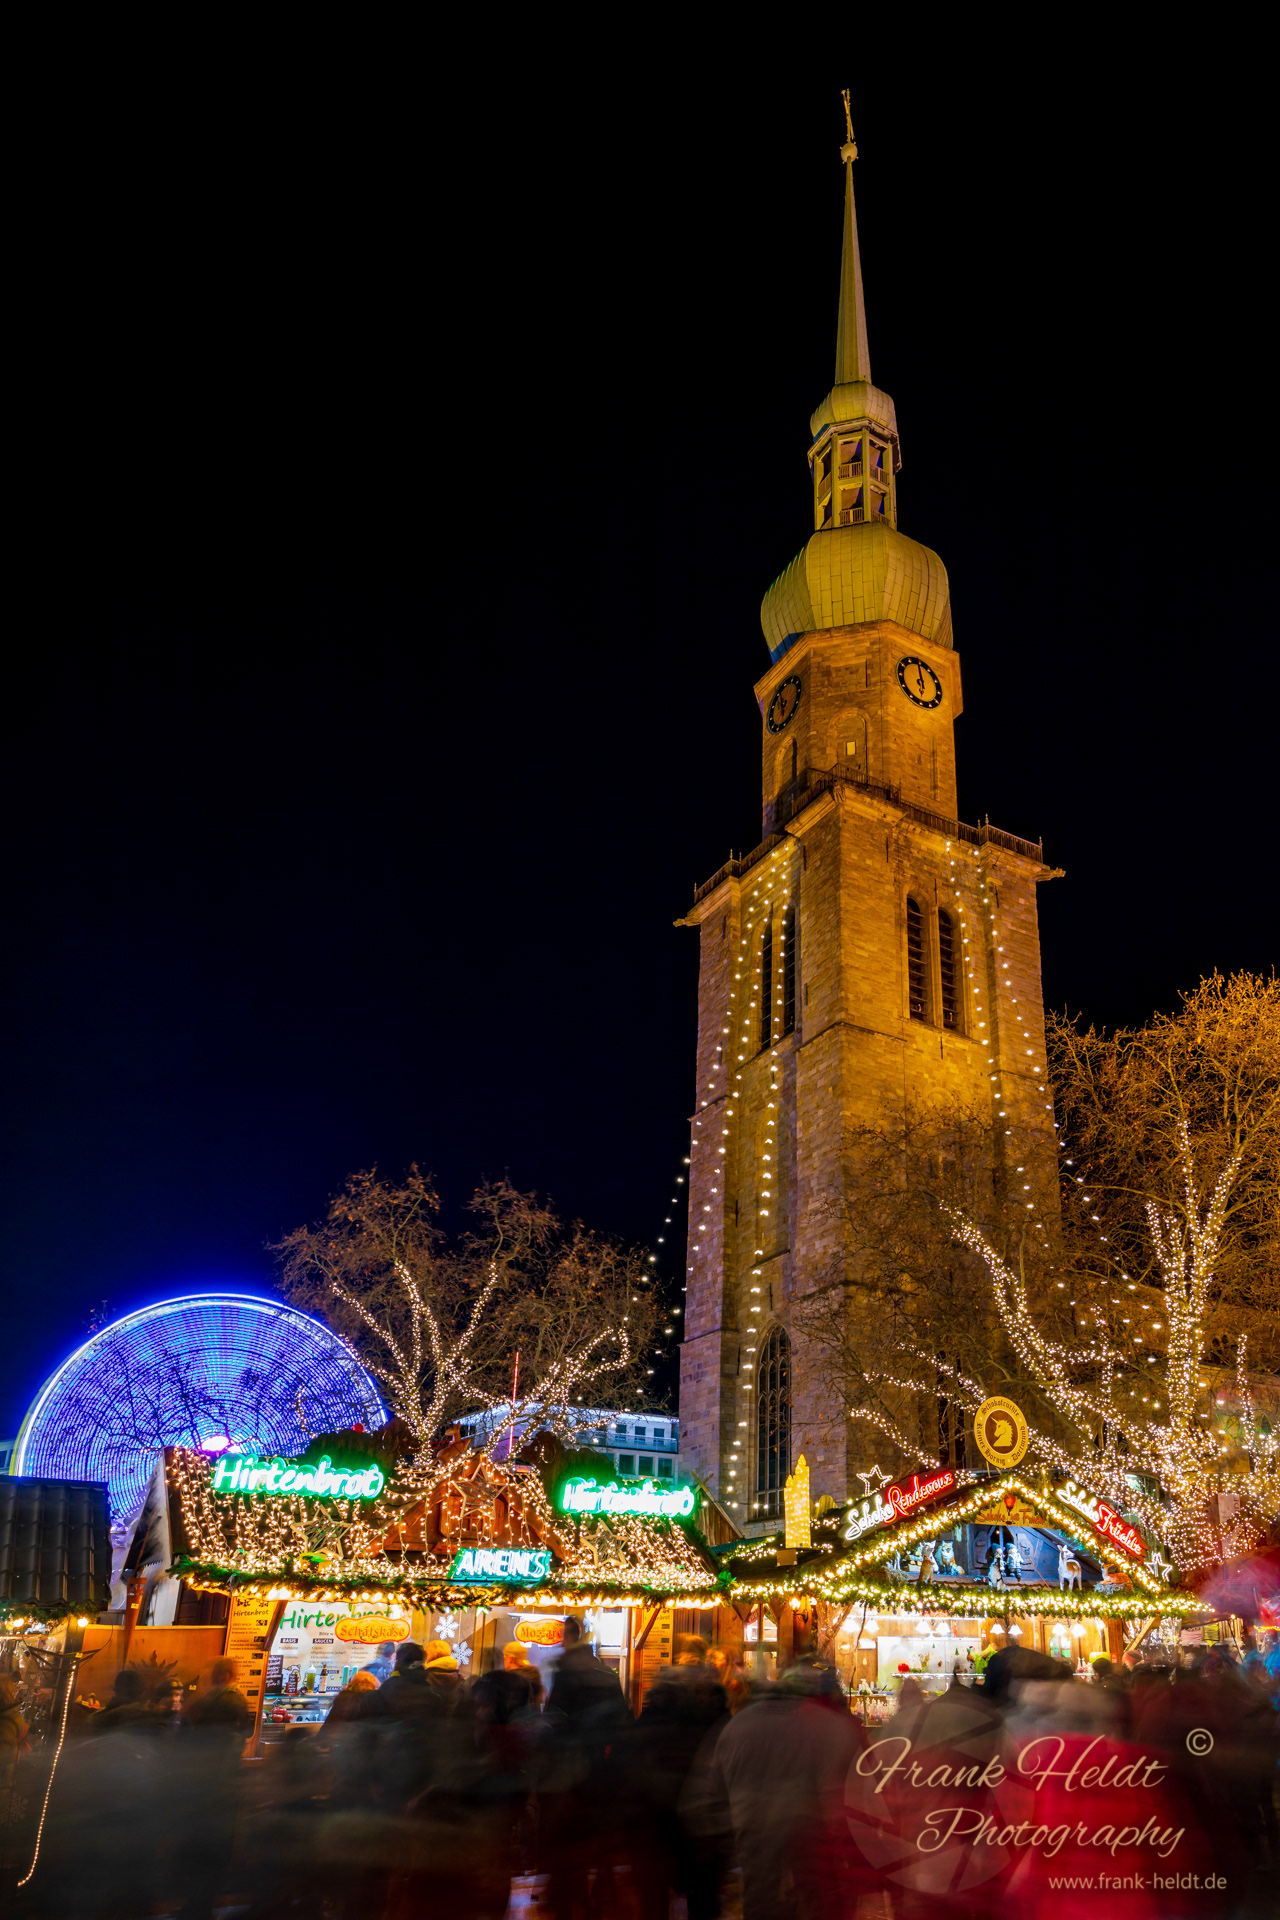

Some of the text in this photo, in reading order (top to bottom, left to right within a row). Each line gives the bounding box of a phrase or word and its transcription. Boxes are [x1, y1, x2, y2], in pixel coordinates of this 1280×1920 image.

[976, 1422, 986, 1449] Rainer
[213, 1454, 383, 1498] Hirtenbrot
[456, 1549, 546, 1579] ARENS
[233, 1608, 269, 1617] Hirtenbrot
[520, 1627, 562, 1638] Mozzare
